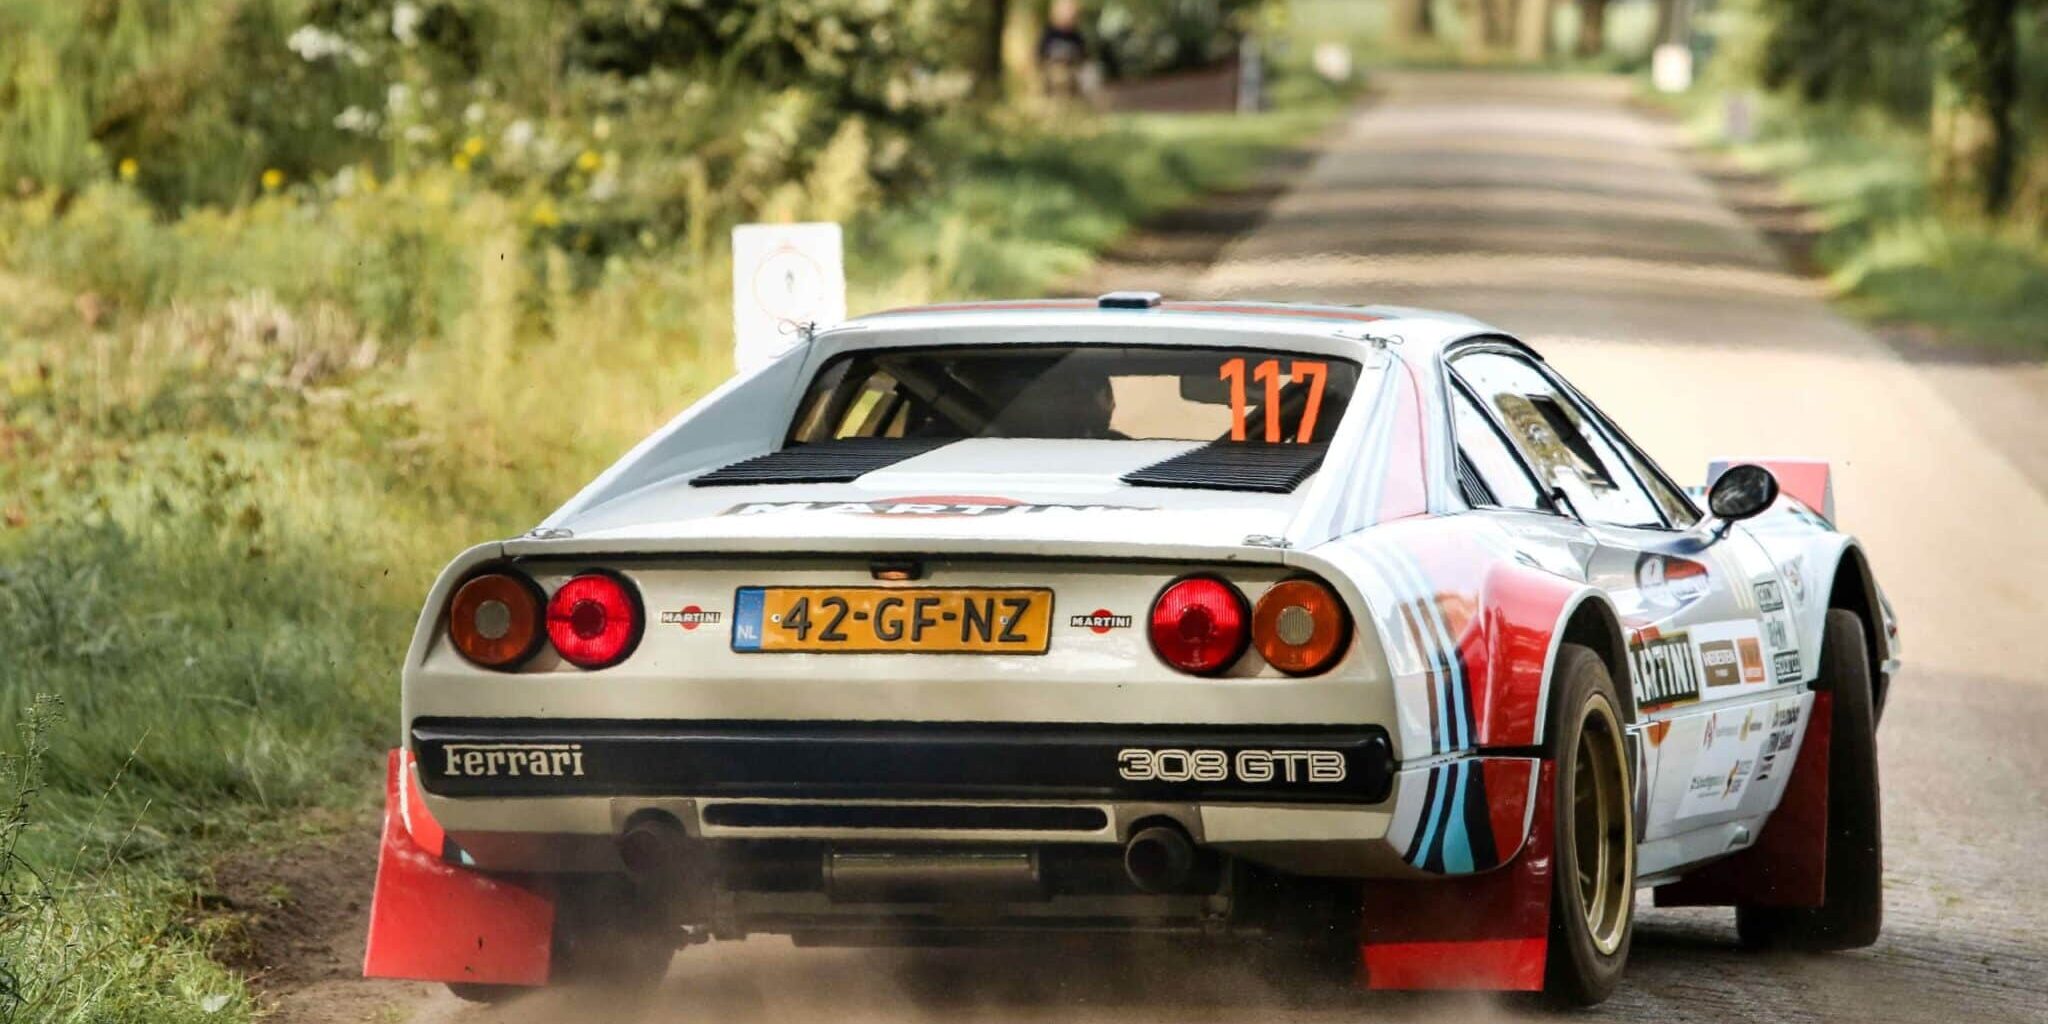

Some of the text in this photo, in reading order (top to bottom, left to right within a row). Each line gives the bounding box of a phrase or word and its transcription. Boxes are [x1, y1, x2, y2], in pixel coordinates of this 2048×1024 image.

[1219, 358, 1328, 444] 117
[662, 612, 720, 623] MARTINI
[737, 624, 758, 640] NL
[782, 596, 1031, 642] 42-GF-NZ
[1072, 616, 1131, 627] MARTINI
[442, 744, 584, 776] Ferrari
[1118, 749, 1346, 782] 308 GTB
